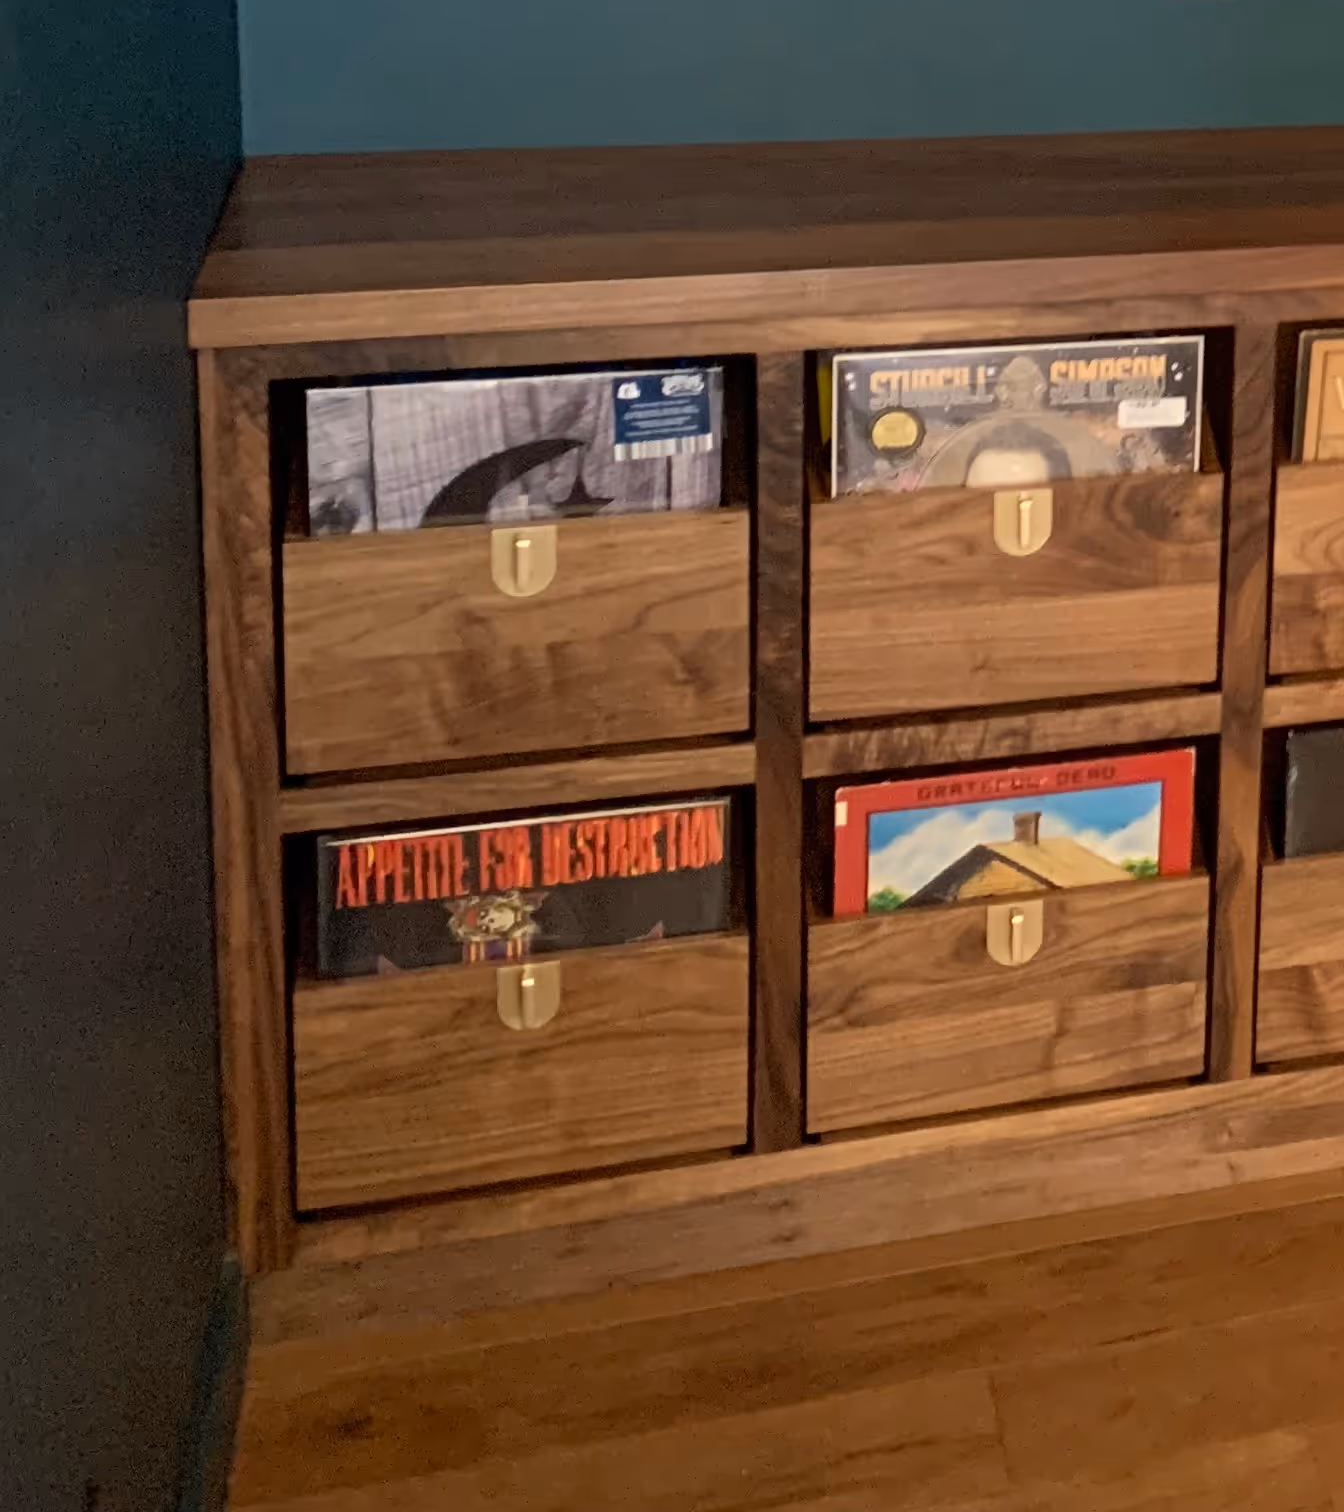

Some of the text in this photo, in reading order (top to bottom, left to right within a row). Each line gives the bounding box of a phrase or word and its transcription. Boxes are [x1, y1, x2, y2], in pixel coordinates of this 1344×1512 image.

[1055, 765, 1117, 787] DEAD
[336, 804, 725, 910] APPETITE FOR DESTRUCTION
